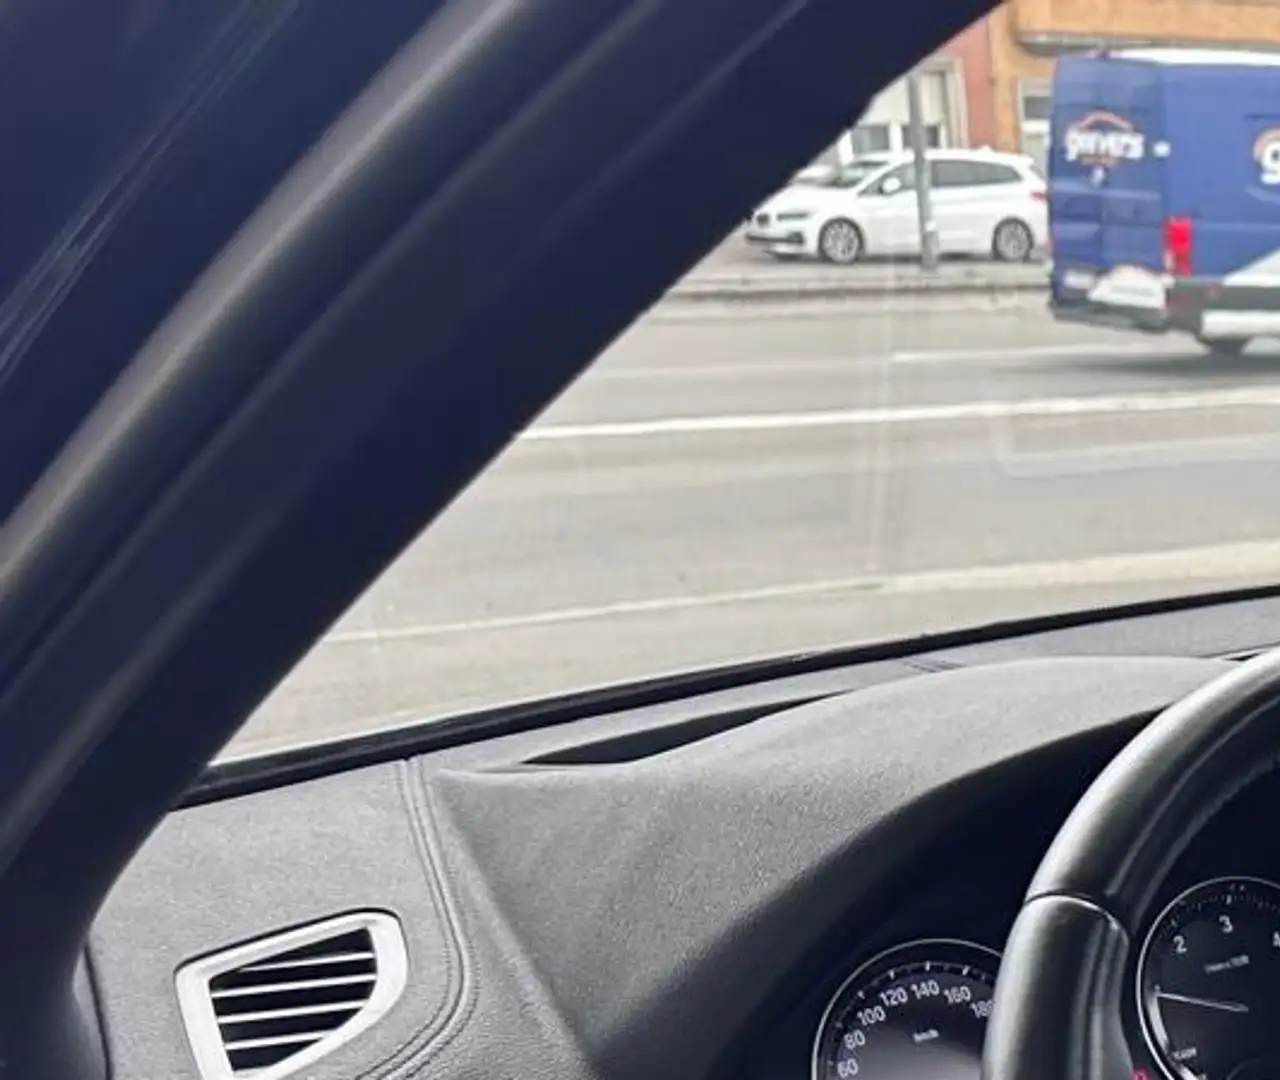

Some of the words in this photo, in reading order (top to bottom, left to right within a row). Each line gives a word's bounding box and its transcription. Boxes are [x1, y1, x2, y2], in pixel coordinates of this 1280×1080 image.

[1219, 915, 1233, 933] 3
[1173, 935, 1188, 953] 2
[880, 987, 909, 1007] 120
[911, 979, 940, 999] 140
[943, 985, 972, 1005] 160
[857, 1005, 887, 1026] 100
[844, 1029, 866, 1050] 80
[837, 1058, 859, 1079] 60
